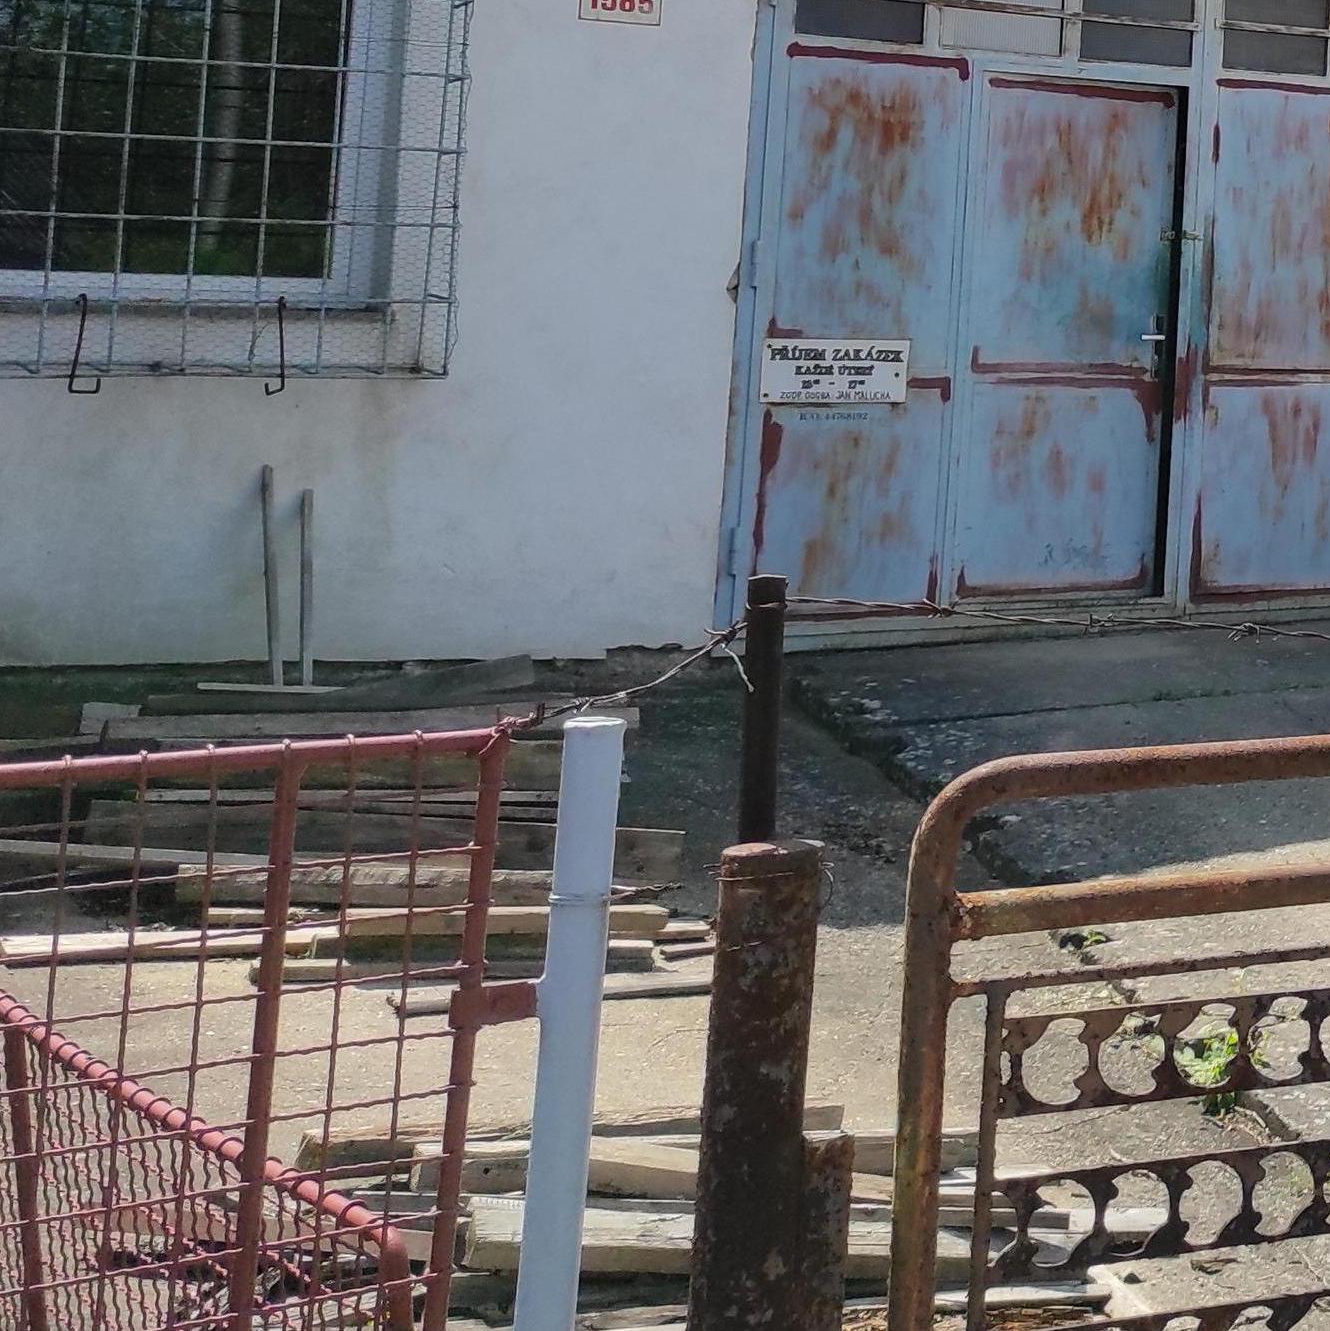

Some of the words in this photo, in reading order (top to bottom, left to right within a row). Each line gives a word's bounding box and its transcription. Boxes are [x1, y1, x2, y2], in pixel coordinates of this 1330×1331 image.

[769, 345, 826, 361] PŘÍJEM
[831, 346, 905, 363] ZAKÁZEK
[853, 391, 891, 401] MALUCHA
